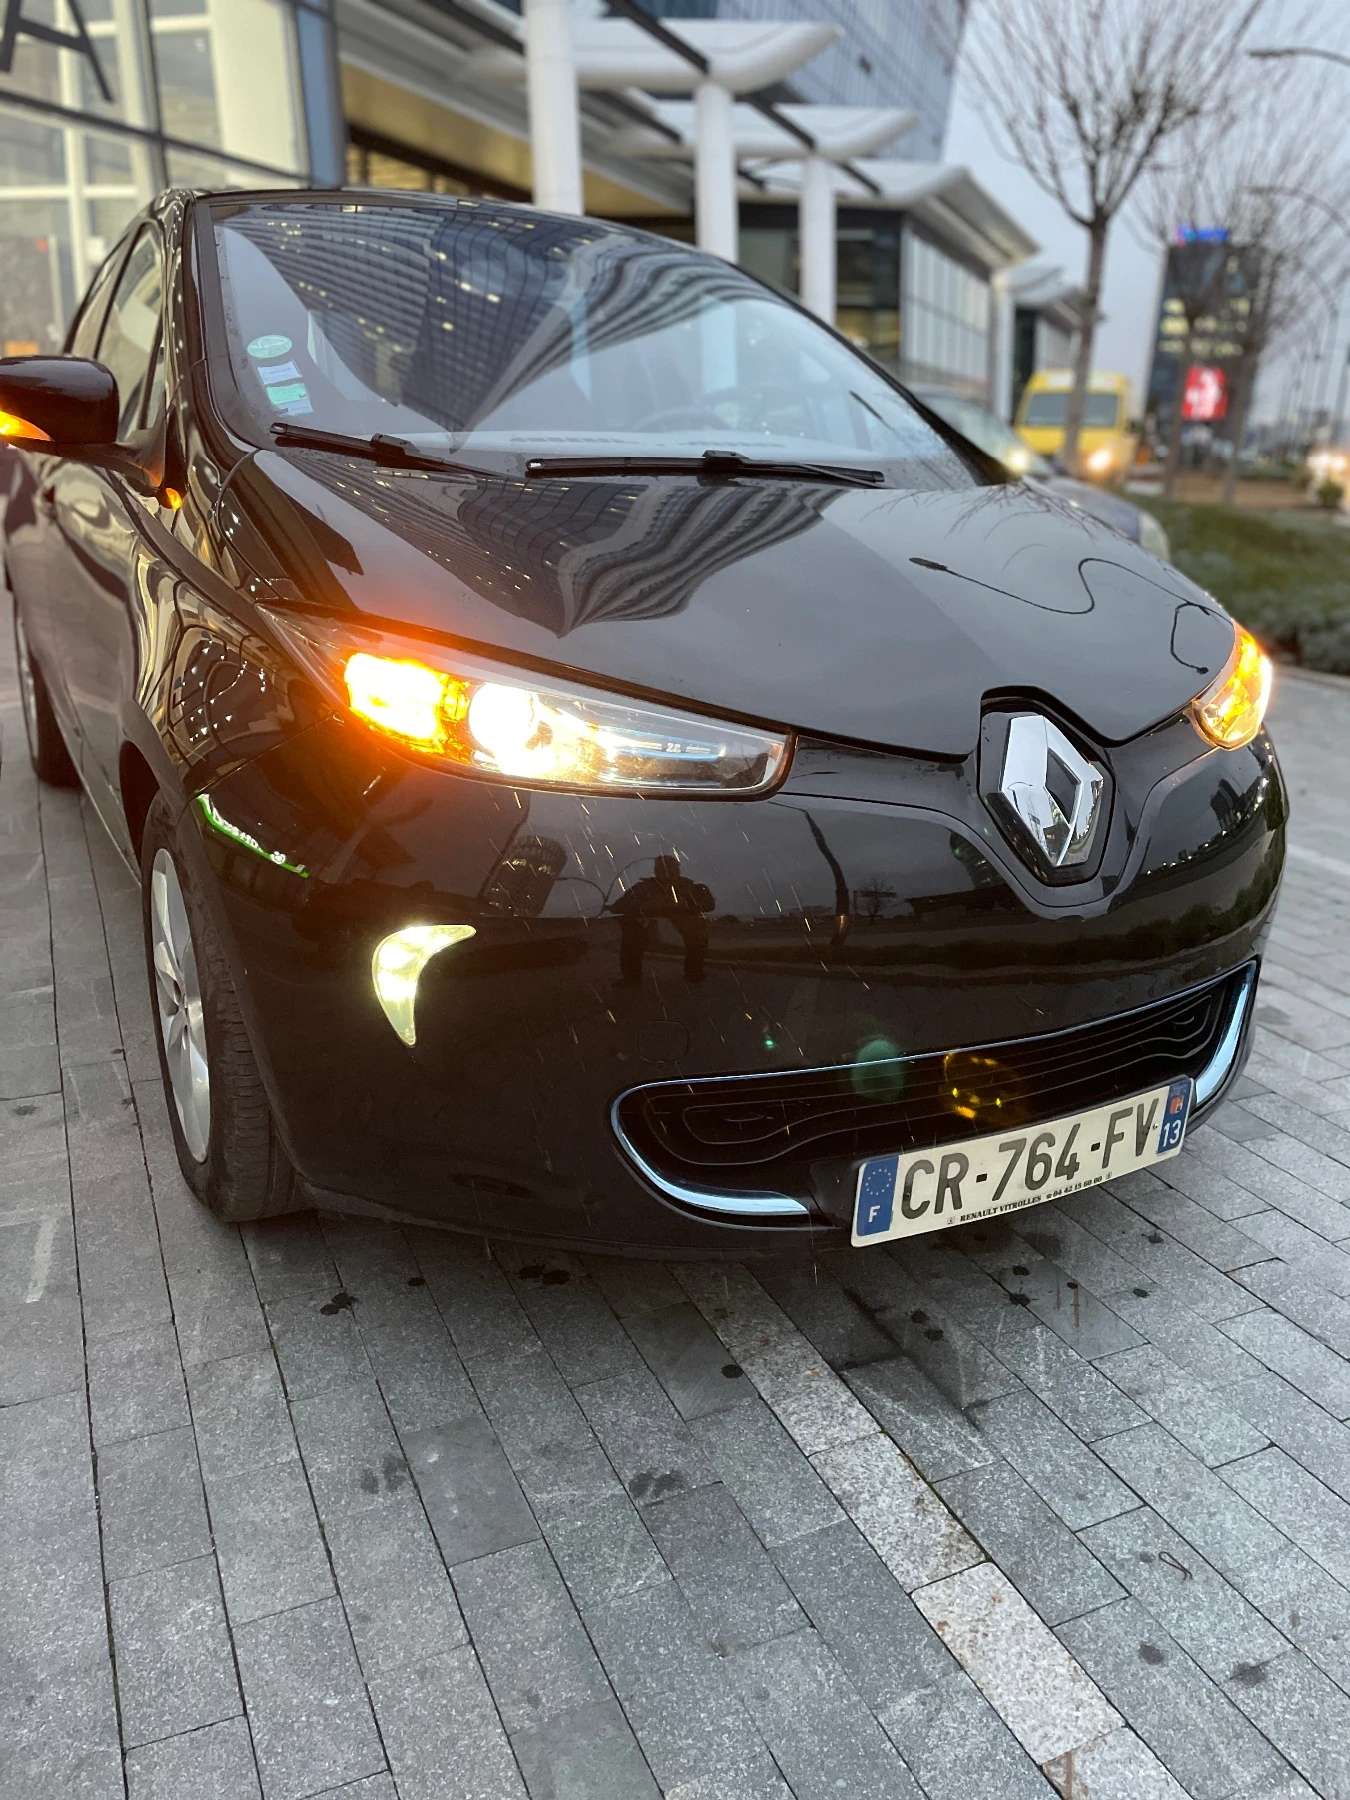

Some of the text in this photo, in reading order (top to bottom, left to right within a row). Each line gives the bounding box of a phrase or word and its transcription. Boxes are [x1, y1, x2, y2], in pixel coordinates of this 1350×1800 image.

[1162, 1119, 1182, 1147] 13
[901, 1097, 1159, 1220] CR-764-FV
[868, 1205, 881, 1223] F
[960, 1207, 998, 1222] RENAULT
[999, 1195, 1042, 1212] VITROLLES
[1053, 1188, 1063, 1197] 04
[1063, 1185, 1073, 1194] 42
